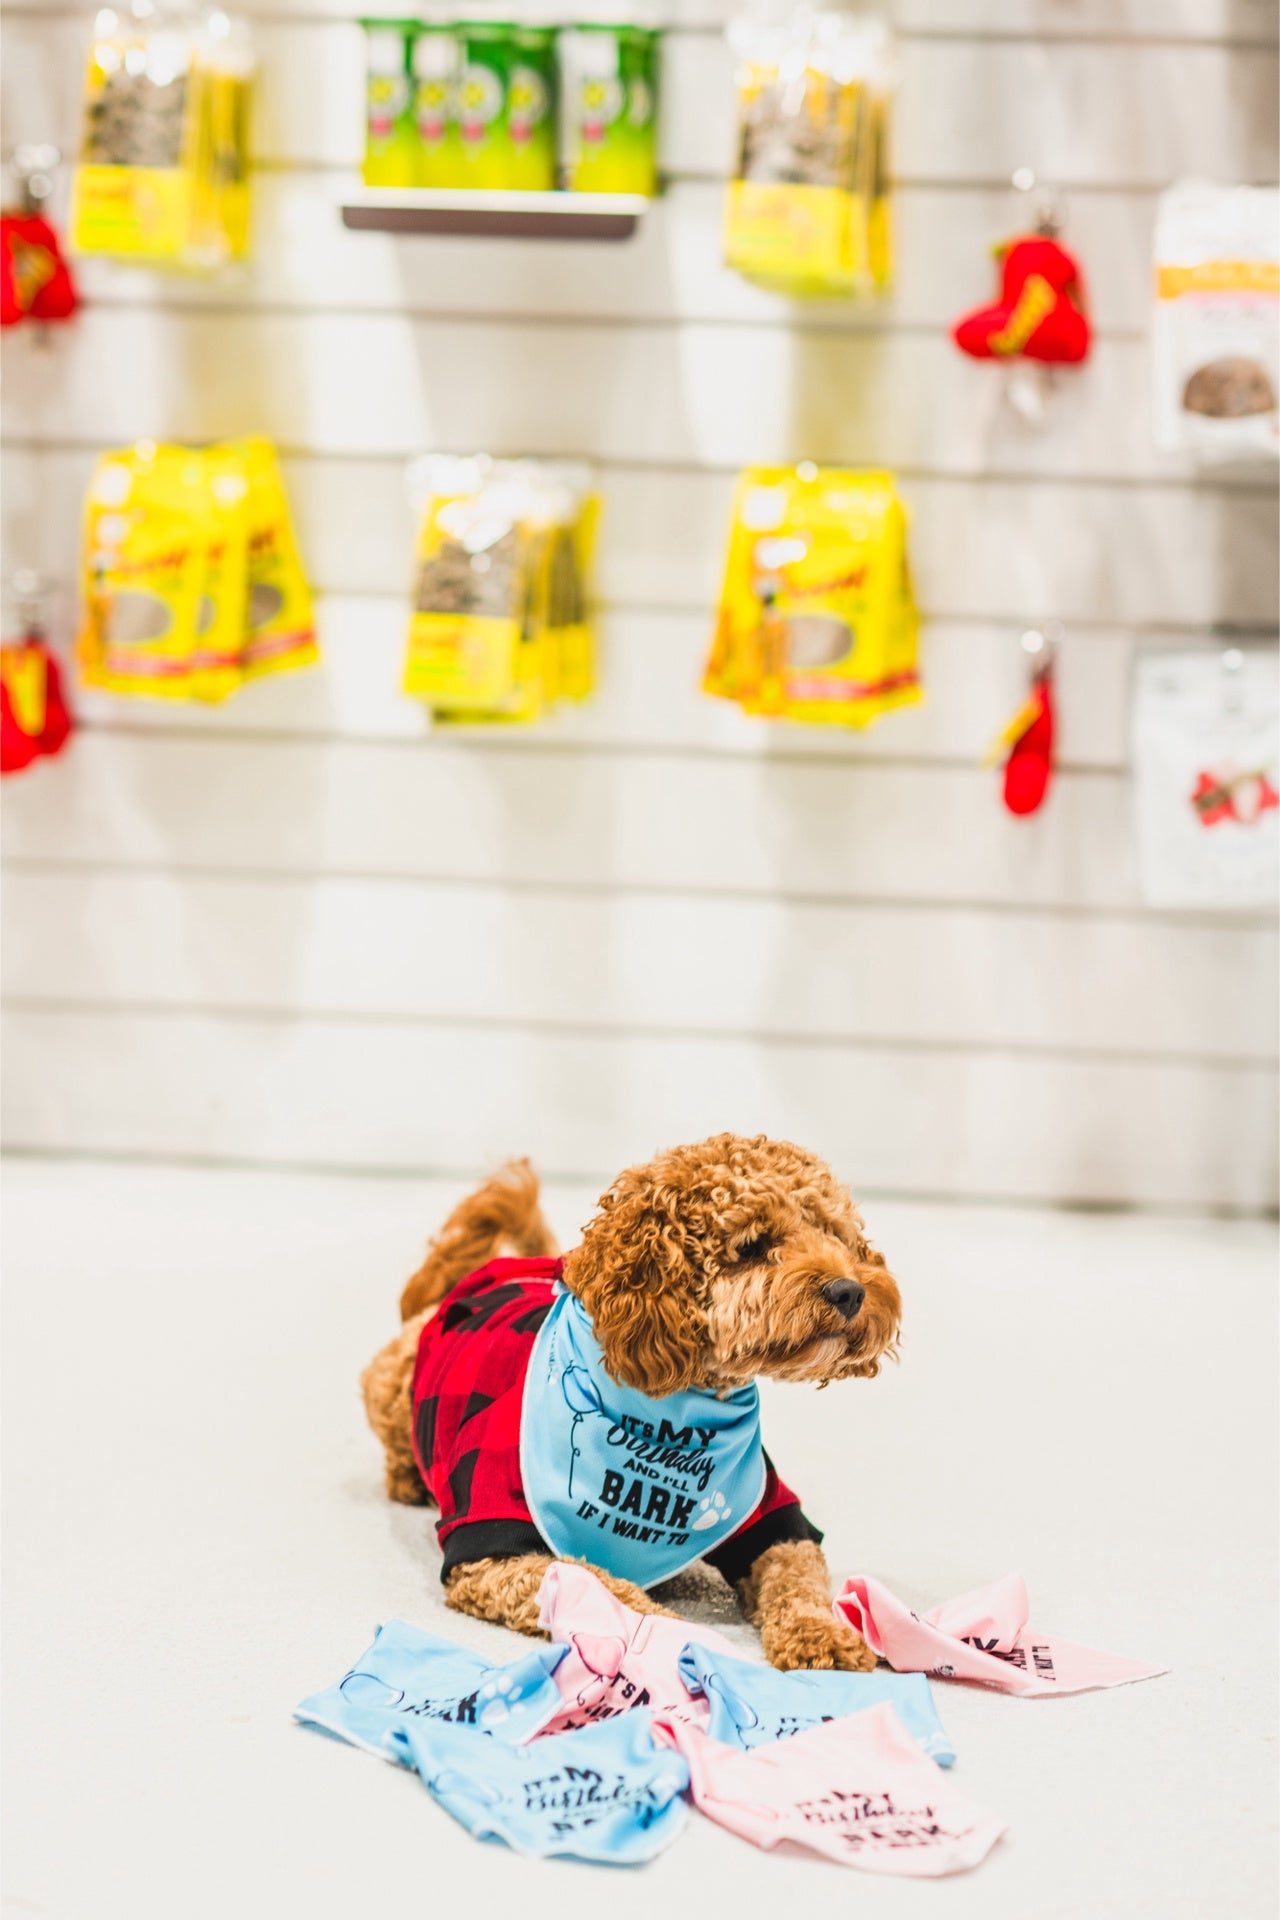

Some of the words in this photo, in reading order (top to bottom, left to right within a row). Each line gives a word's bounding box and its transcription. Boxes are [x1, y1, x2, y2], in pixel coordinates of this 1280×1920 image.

[621, 1414, 655, 1438] IT'S
[656, 1418, 717, 1447] MY
[623, 1458, 660, 1480] AND
[662, 1477, 690, 1492] I'LL
[598, 1469, 698, 1529] BARK
[575, 1500, 599, 1519] IF
[598, 1513, 610, 1529] I
[612, 1518, 666, 1544] WANT
[669, 1532, 690, 1546] TO
